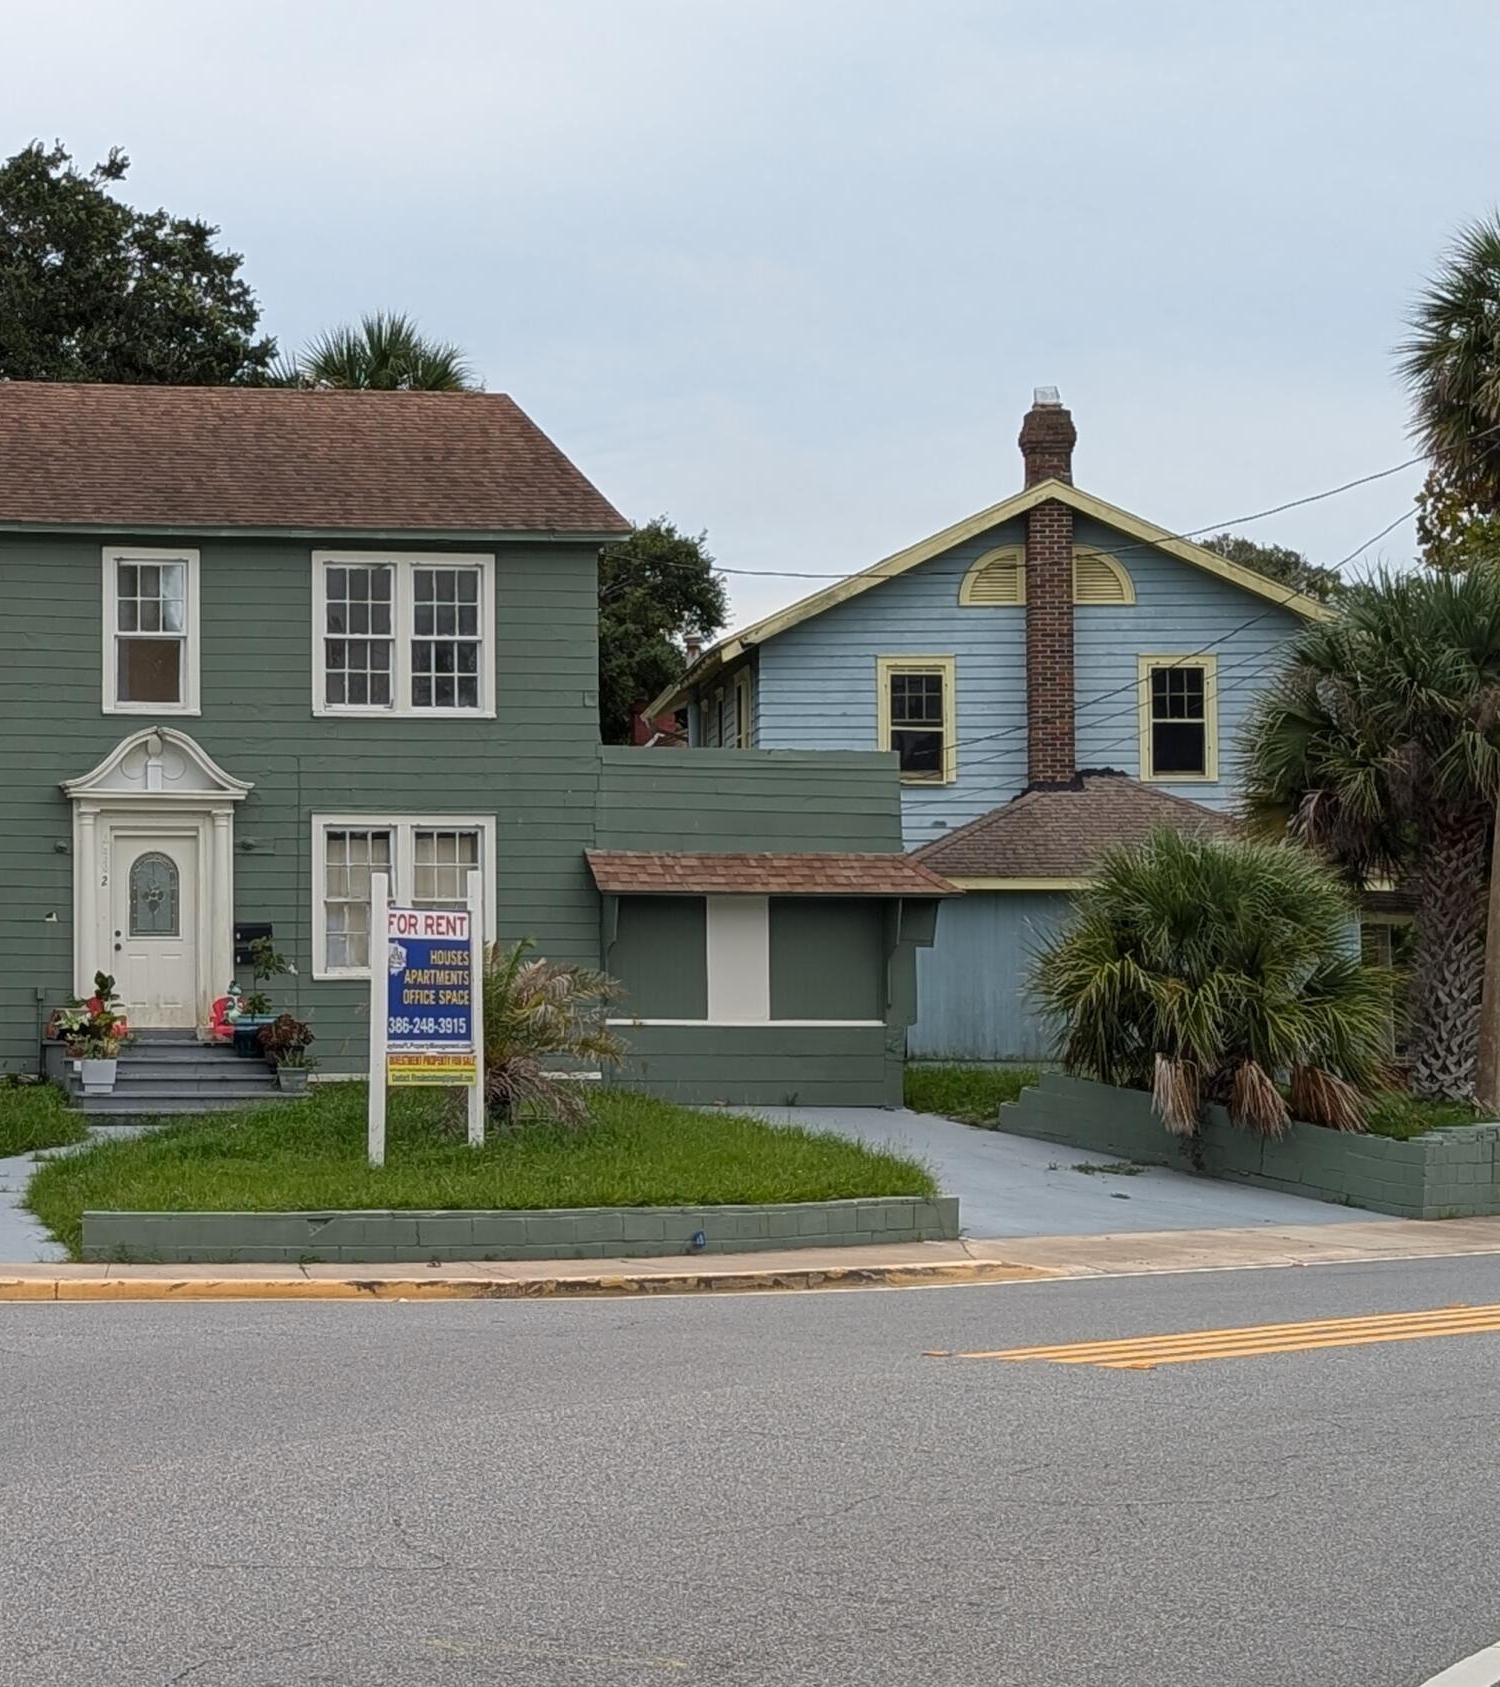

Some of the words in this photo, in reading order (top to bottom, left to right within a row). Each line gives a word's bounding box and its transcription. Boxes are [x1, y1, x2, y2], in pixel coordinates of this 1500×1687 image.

[100, 874, 109, 888] 2
[388, 914, 418, 935] FOR
[425, 915, 467, 937] RENT
[429, 949, 469, 966] HOUSES
[404, 969, 469, 985] APARTMENTS
[403, 989, 436, 1005] OFFICE
[439, 989, 469, 1005] SPACE
[388, 1016, 467, 1034] 386-248-3915
